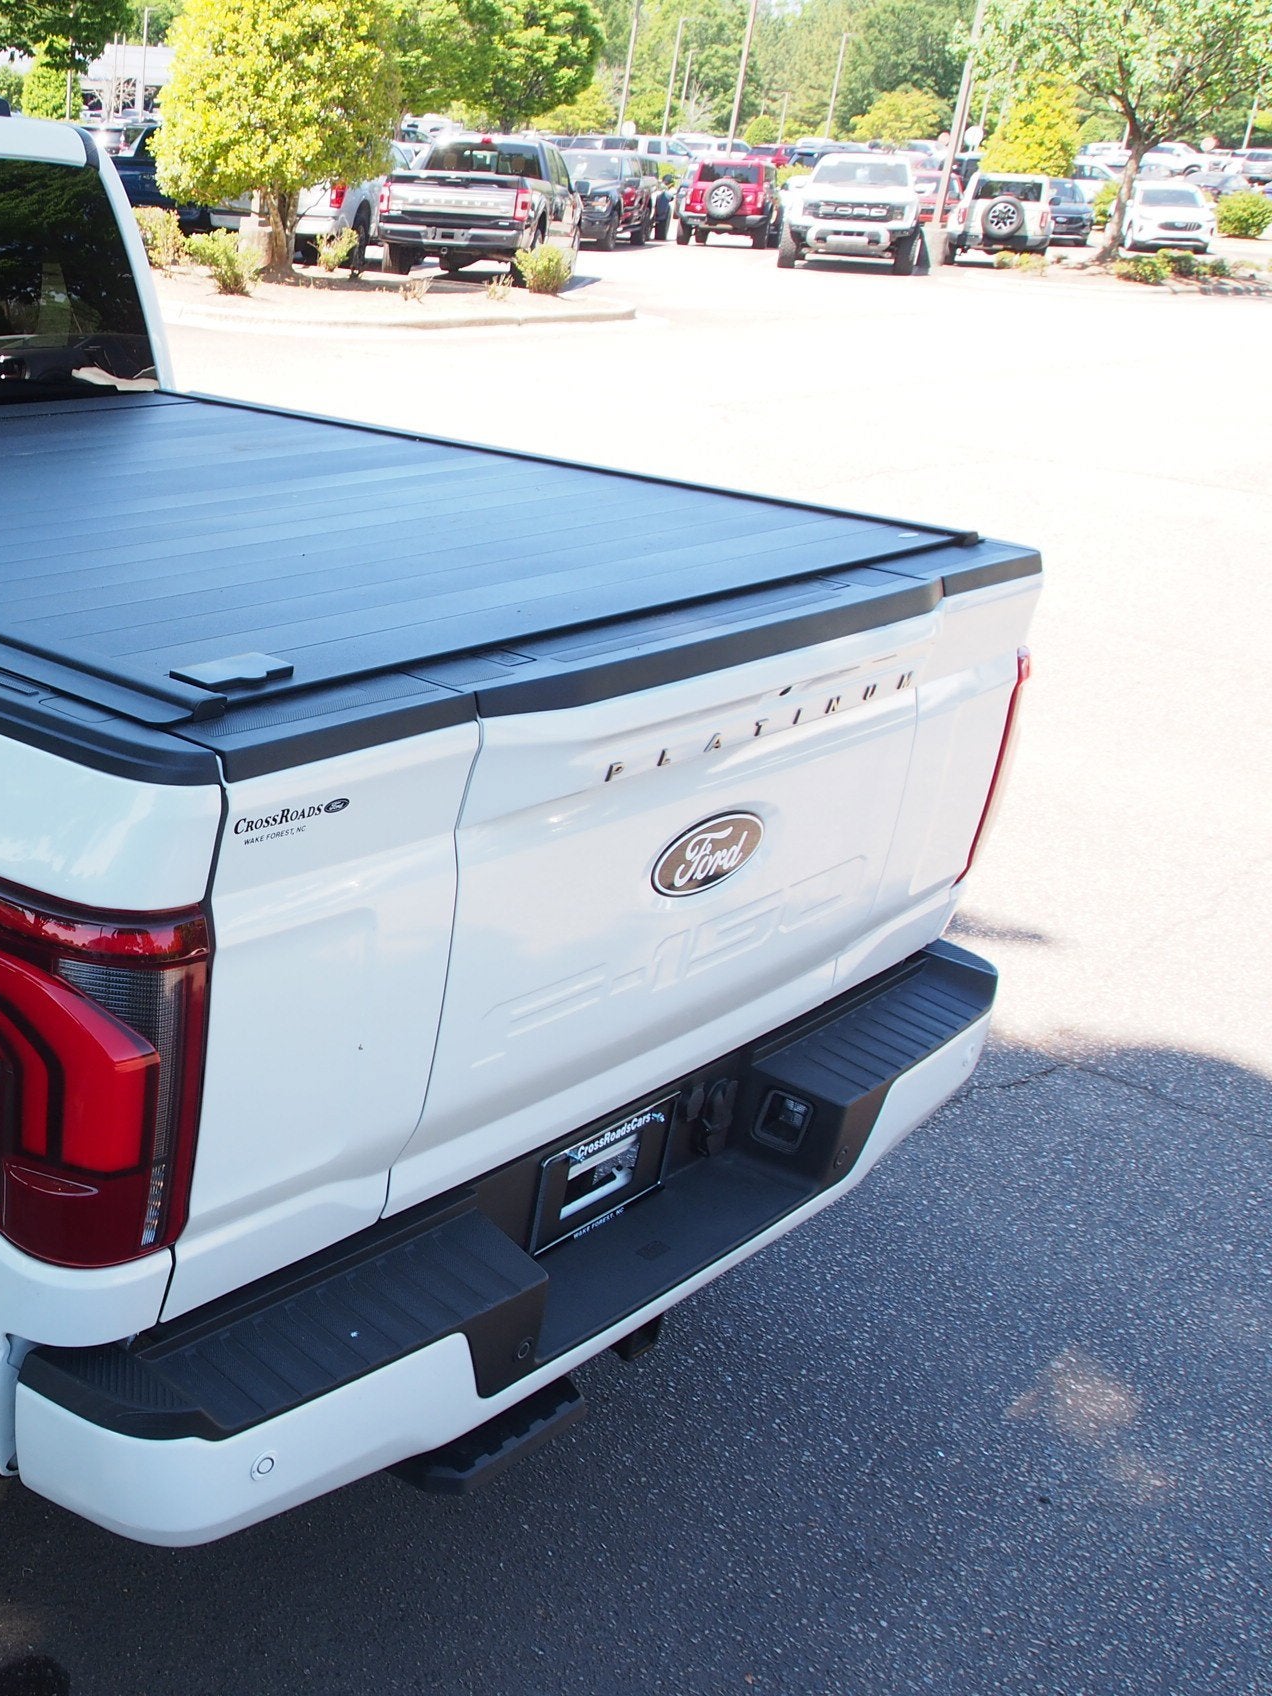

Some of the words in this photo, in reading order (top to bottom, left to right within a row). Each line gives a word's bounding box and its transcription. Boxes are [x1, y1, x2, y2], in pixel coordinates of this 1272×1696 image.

[819, 205, 887, 217] FORD
[604, 670, 915, 782] PLATINUM
[244, 835, 264, 846] WAKE
[296, 825, 307, 833] NC
[671, 824, 750, 889] Ford
[577, 1112, 652, 1159] CrossRoadsCars
